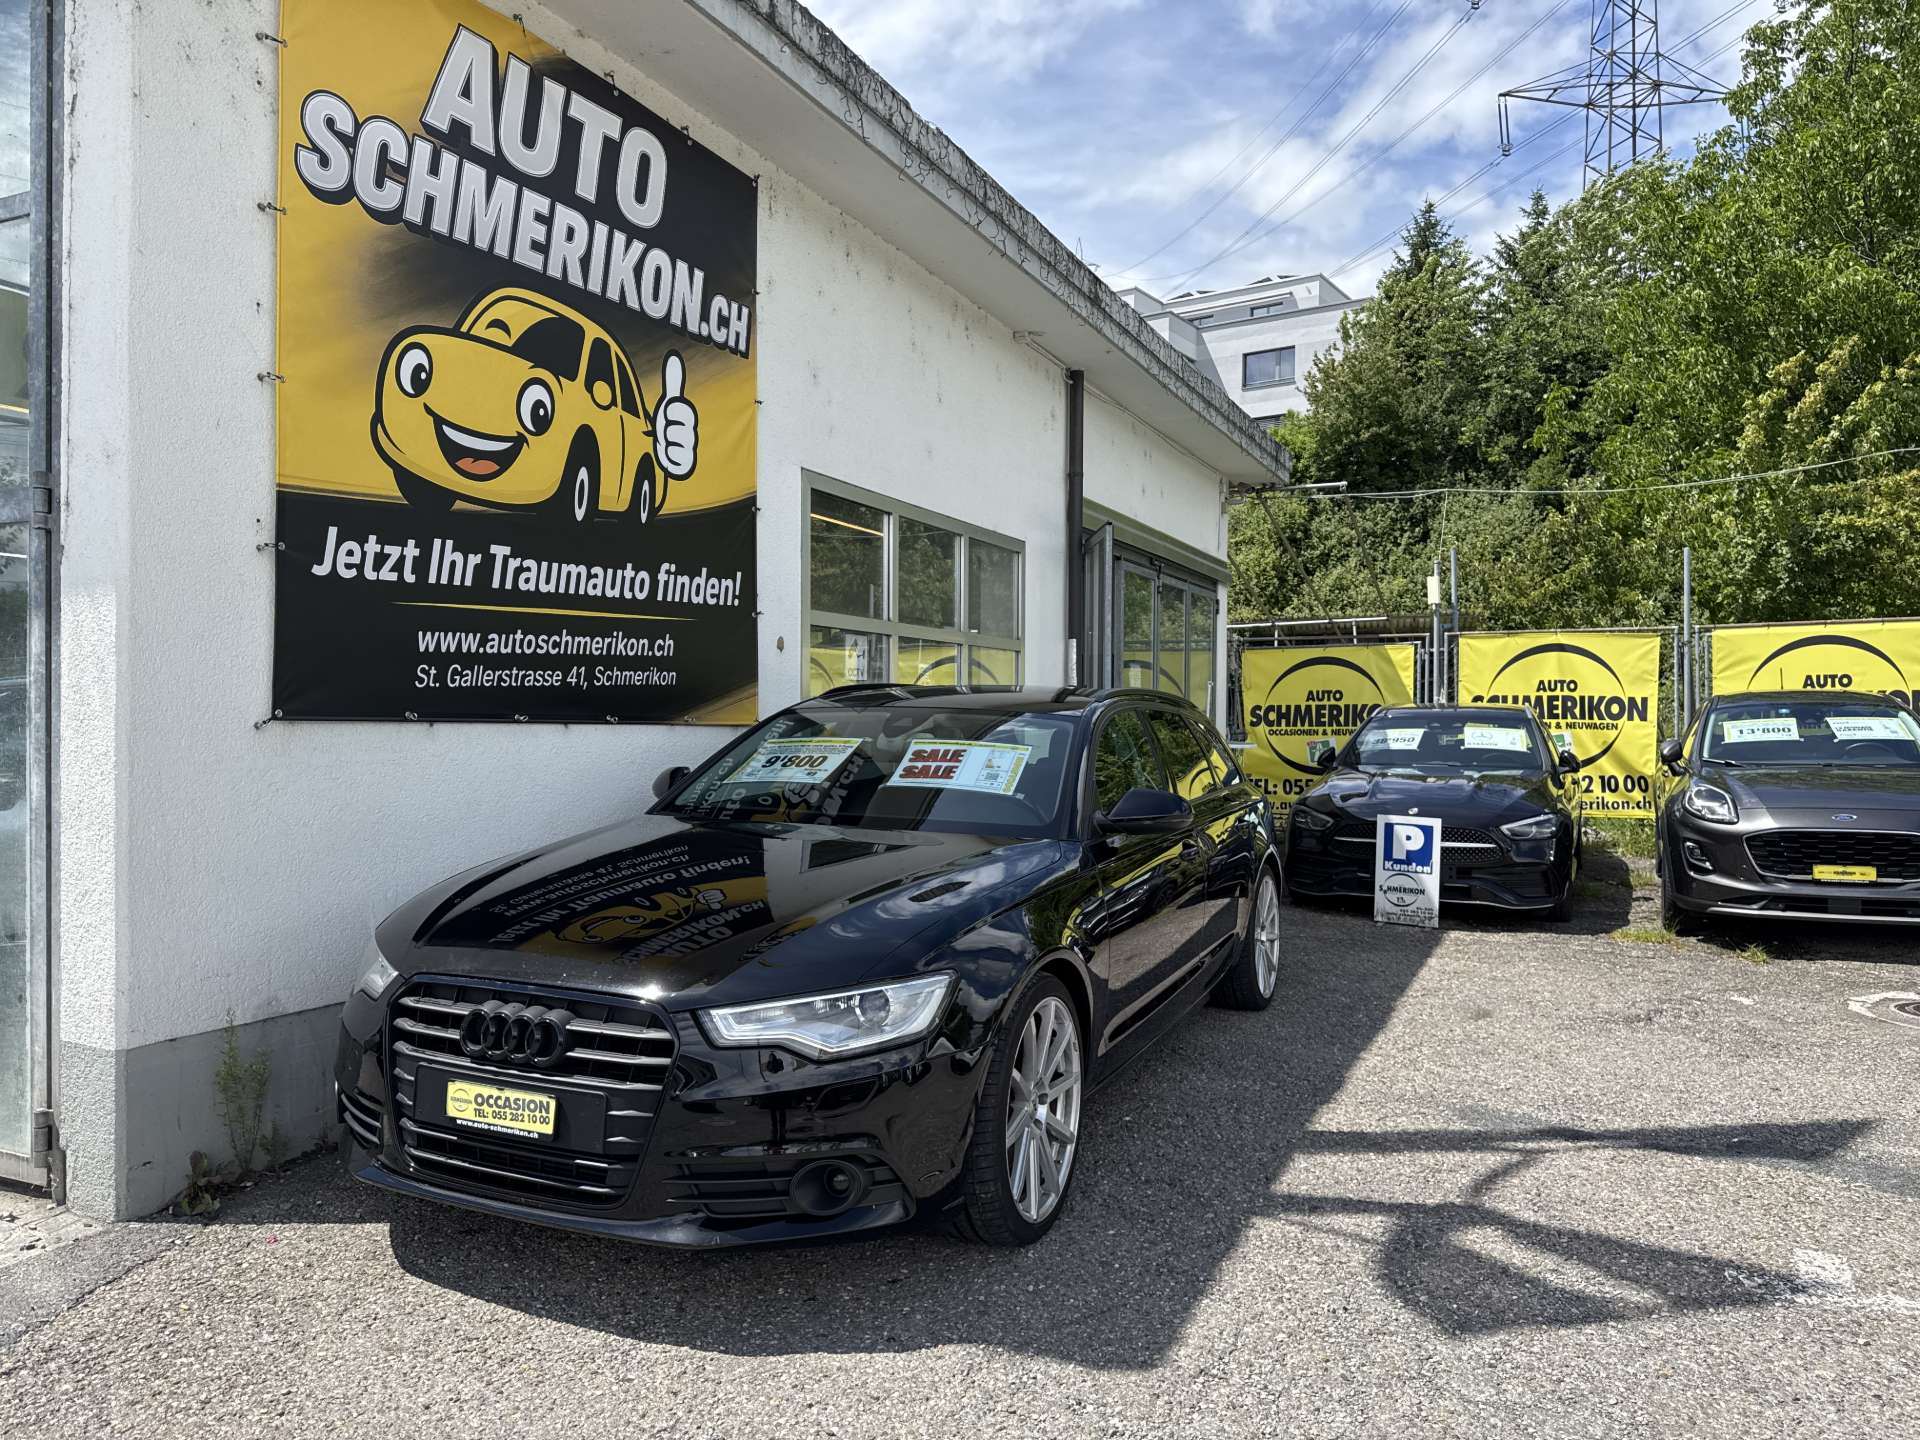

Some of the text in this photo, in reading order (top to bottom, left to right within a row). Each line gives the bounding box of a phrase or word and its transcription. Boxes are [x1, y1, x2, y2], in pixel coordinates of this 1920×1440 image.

[423, 25, 668, 229] AUTO
[297, 93, 750, 353] SCHMERIKON.CH
[311, 526, 742, 607] Jetzt Ihr Traumauto finden!
[418, 629, 674, 657] www.autoschmerikon.ch
[415, 664, 677, 690] St. Gallerstrasse 41, Schmerikon
[1803, 673, 1853, 689] AUTO
[1536, 679, 1578, 693] AUTO
[1305, 690, 1344, 702] AUTO
[1250, 703, 1382, 728] SCHMERIK
[1268, 728, 1319, 737] OCCASIONEN
[1321, 728, 1328, 736] &
[1555, 721, 1562, 730] &
[1566, 721, 1619, 731] NEUWAGEN
[1737, 726, 1792, 735] 13'800
[761, 755, 828, 768] 9'800
[908, 748, 968, 763] SALE
[899, 764, 959, 779] SALE
[1599, 775, 1619, 793] 10
[1623, 774, 1649, 793] 00
[1392, 824, 1425, 860] P
[474, 1093, 550, 1114] OCCASION
[474, 1108, 551, 1125] TEL: 055 282 10 00
